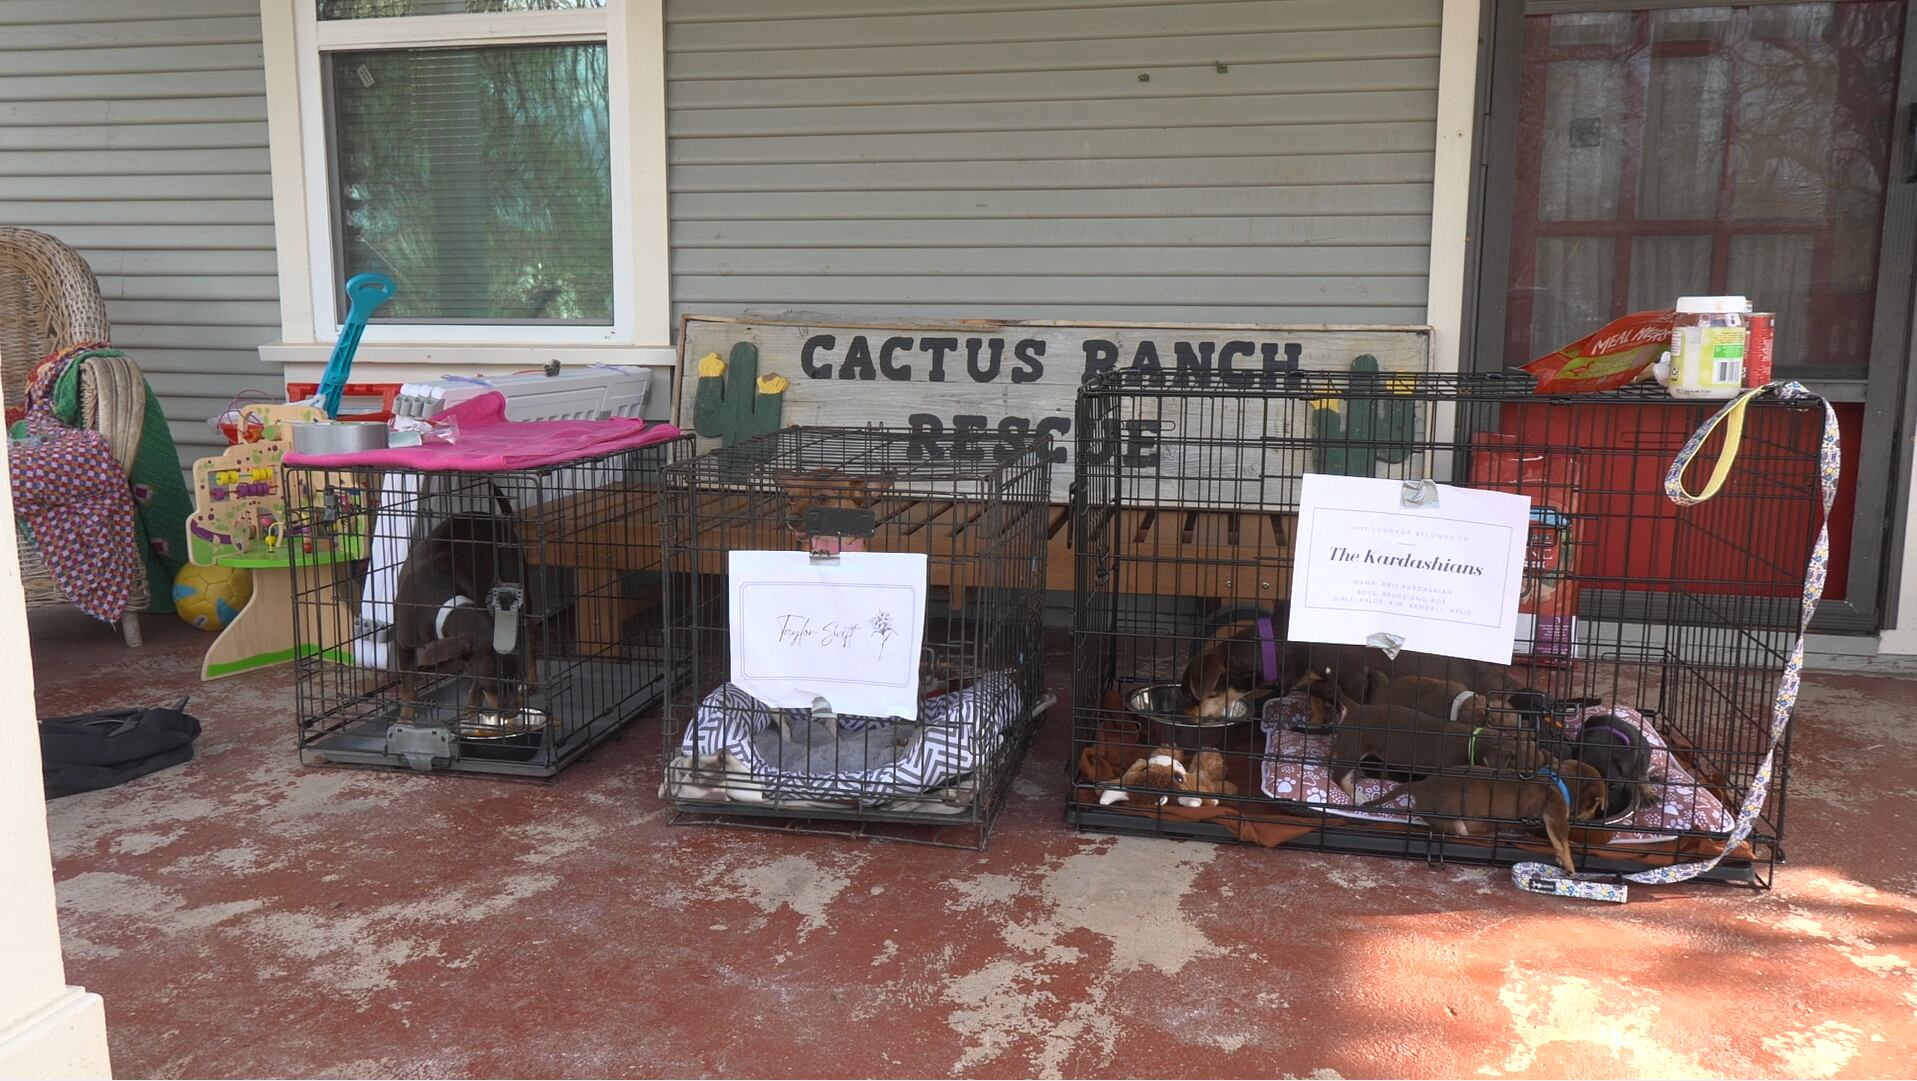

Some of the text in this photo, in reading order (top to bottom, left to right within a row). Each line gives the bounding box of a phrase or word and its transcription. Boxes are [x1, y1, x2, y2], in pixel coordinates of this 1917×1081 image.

[1591, 330, 1633, 356] MEAL
[801, 334, 1302, 388] CACTUS RANCH
[1372, 528, 1411, 537] LUGGAGE
[1416, 531, 1454, 540] BELONGS
[1329, 546, 1484, 576] The Kardashians
[1382, 591, 1407, 600] BRUCE
[1402, 584, 1454, 595] KARDASHIAN
[1449, 608, 1471, 616] KYLIE
[821, 620, 861, 648] Swift
